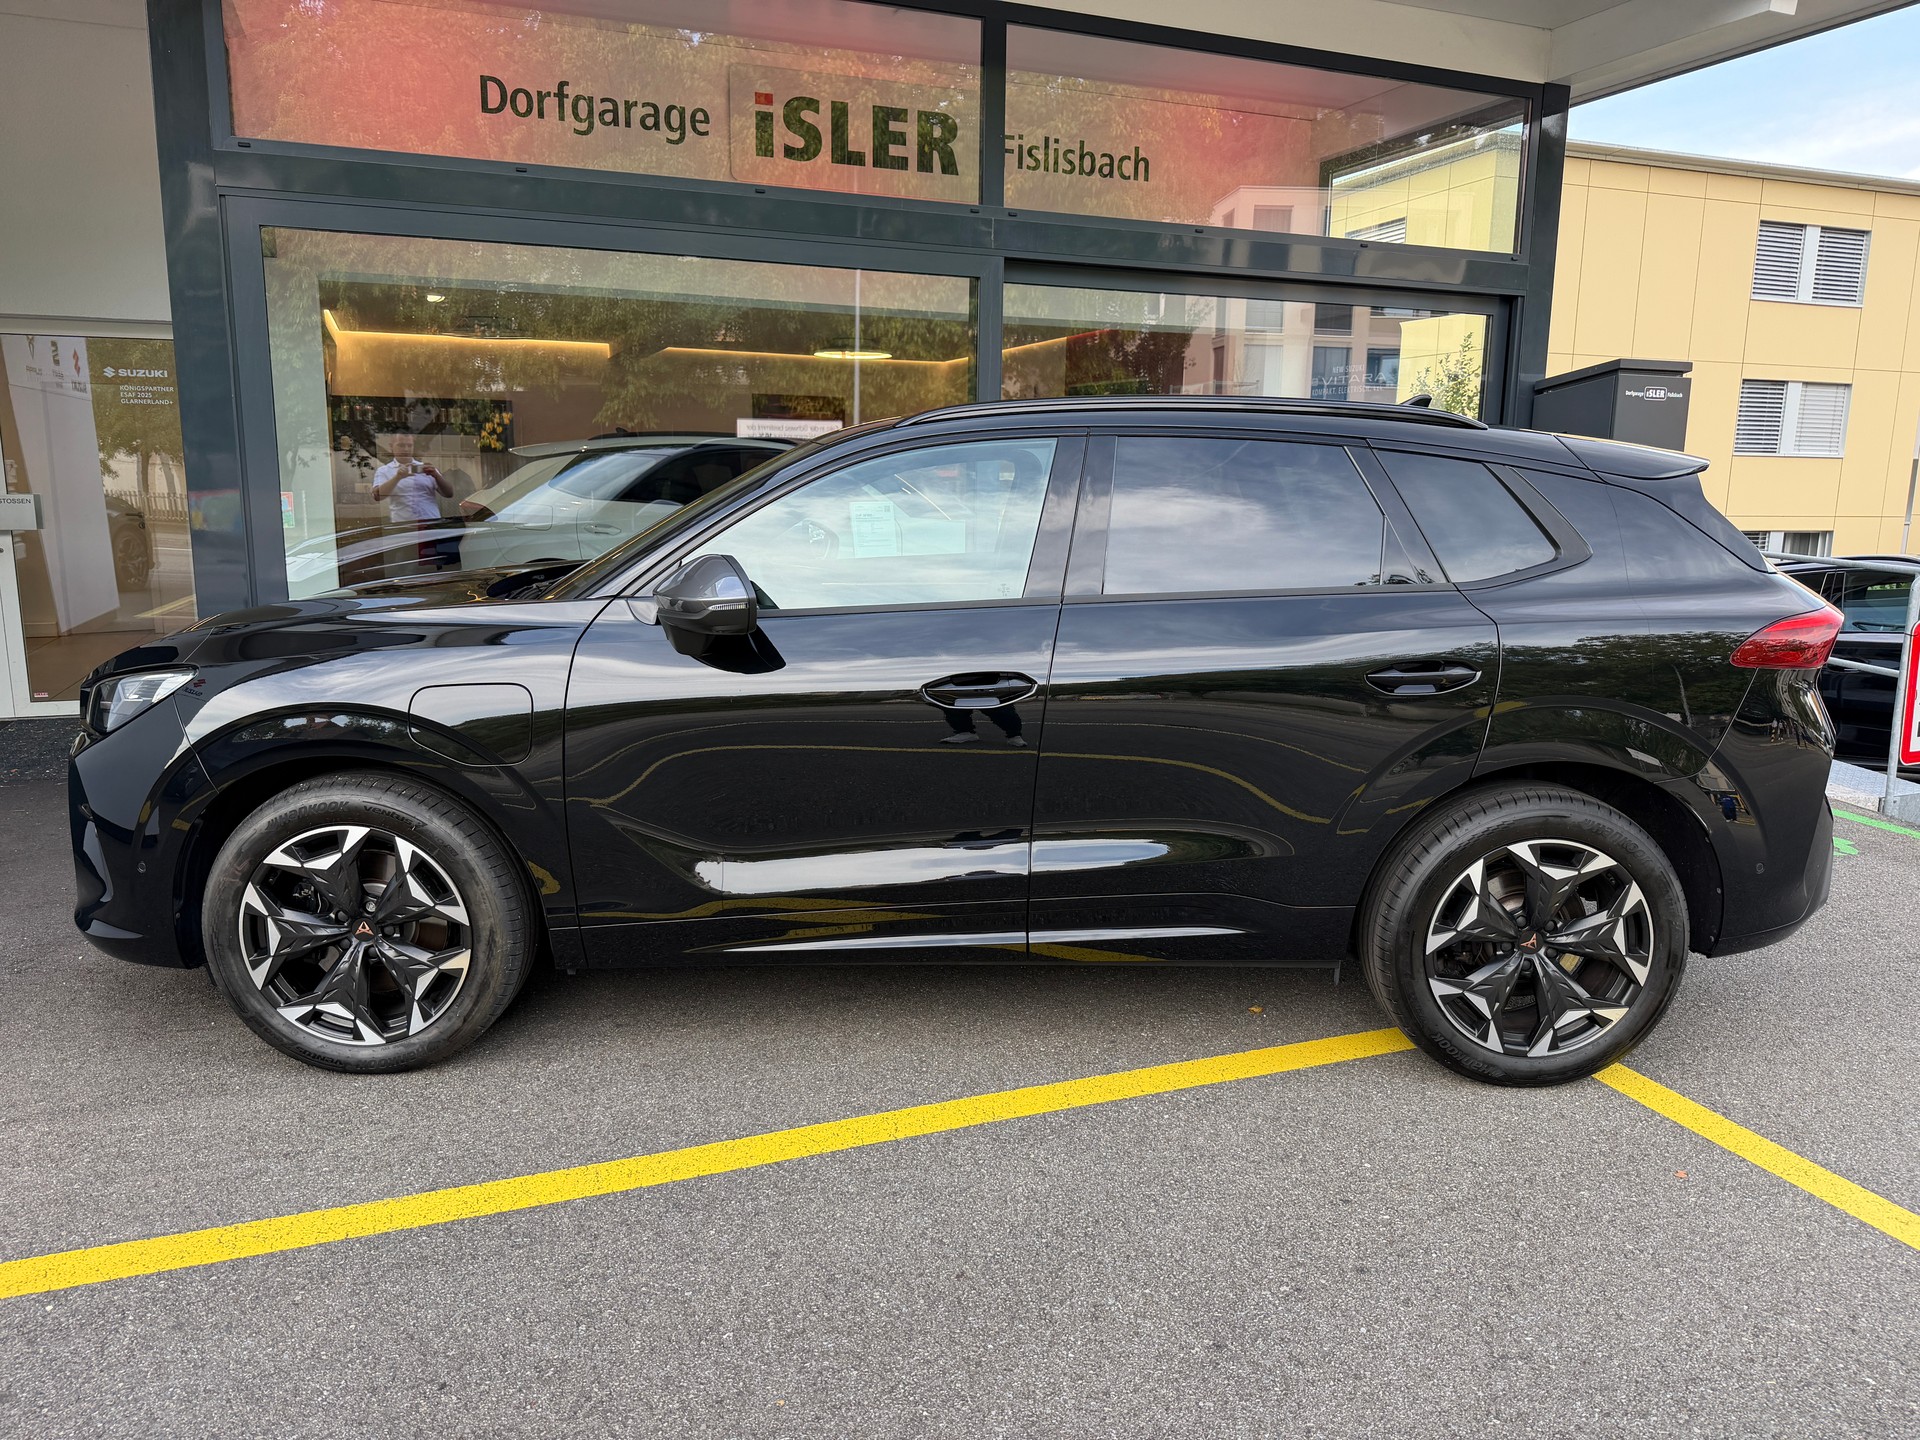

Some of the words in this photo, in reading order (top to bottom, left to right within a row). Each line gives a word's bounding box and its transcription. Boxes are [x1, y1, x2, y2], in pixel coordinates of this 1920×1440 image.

[479, 74, 711, 145] Dorfgarage
[754, 91, 960, 177] iSLER
[117, 368, 169, 378] SUZUKI
[1321, 372, 1387, 386] VITARA
